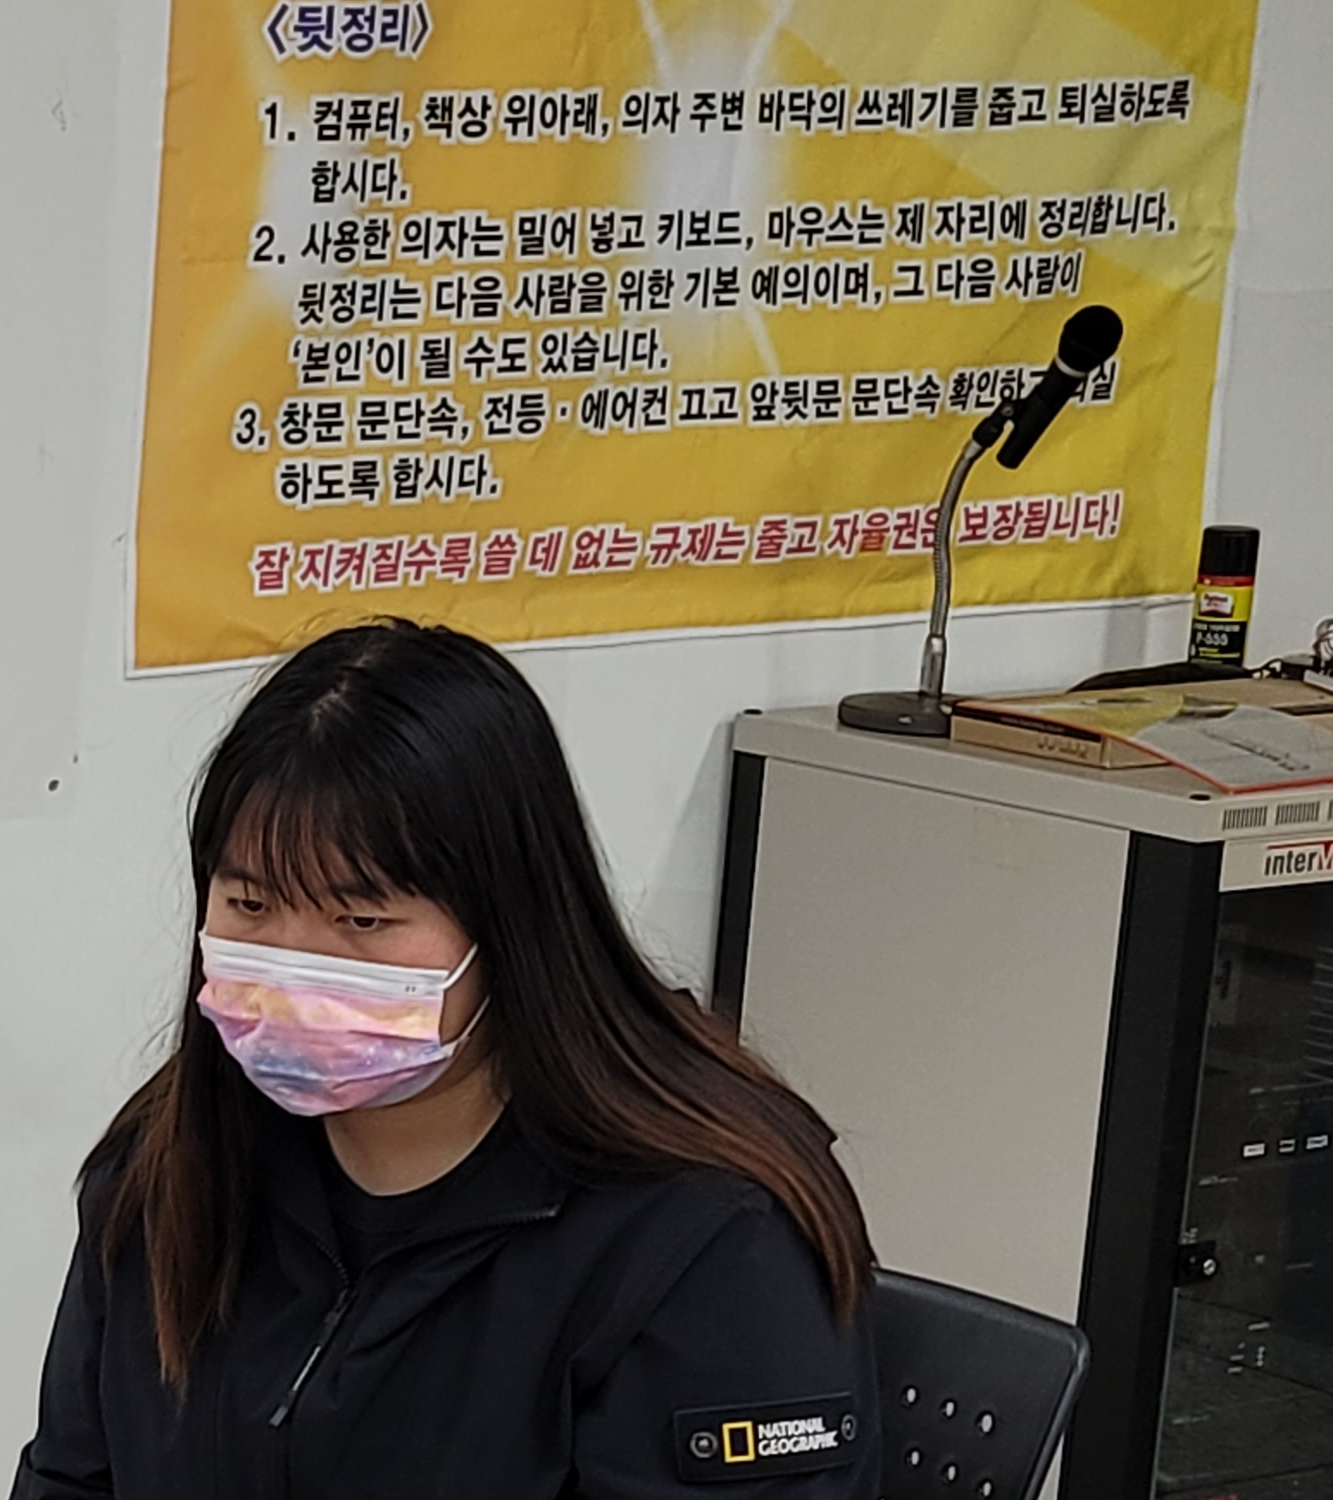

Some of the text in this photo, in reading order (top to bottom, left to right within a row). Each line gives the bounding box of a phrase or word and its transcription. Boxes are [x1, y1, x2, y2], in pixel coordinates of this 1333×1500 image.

[264, 79, 1190, 142] 1. 컴퓨터, 책상 위아래, 의자 주변 바닥의 쓰레기를 줍고 퇴실하도록
[311, 157, 408, 203] 합시다.
[252, 191, 1176, 264] 2. 사용한 의자는 밀어 넣고 키보드, 마우스는 제 자리에 정리합니다.
[298, 252, 1083, 325] 뒷정리는 다음 사람을 위한 기본 예의이며, 그 다음 사람이
[420, 336, 451, 380] 될
[463, 335, 528, 379] 수도
[540, 327, 669, 375] 있습니다.
[236, 407, 266, 447] 3.
[280, 400, 345, 446] 창문
[357, 396, 470, 441] 문단속,
[484, 392, 546, 436] 전등
[581, 386, 668, 431] 에어컨
[679, 386, 739, 421] 끄고
[750, 378, 843, 422] 앞뒷문
[852, 373, 942, 417] 문단속
[280, 453, 499, 504] 하도록 합시다.
[254, 545, 291, 592] 잘
[299, 535, 473, 588] 지켜질수록
[482, 532, 519, 577] 쓸
[528, 530, 564, 573] 데
[572, 527, 639, 571] 없는
[649, 521, 747, 566] 규제는
[754, 518, 819, 560] 줄고
[958, 493, 1121, 543] 보장됩니다!
[757, 1416, 827, 1439] NATIONAL
